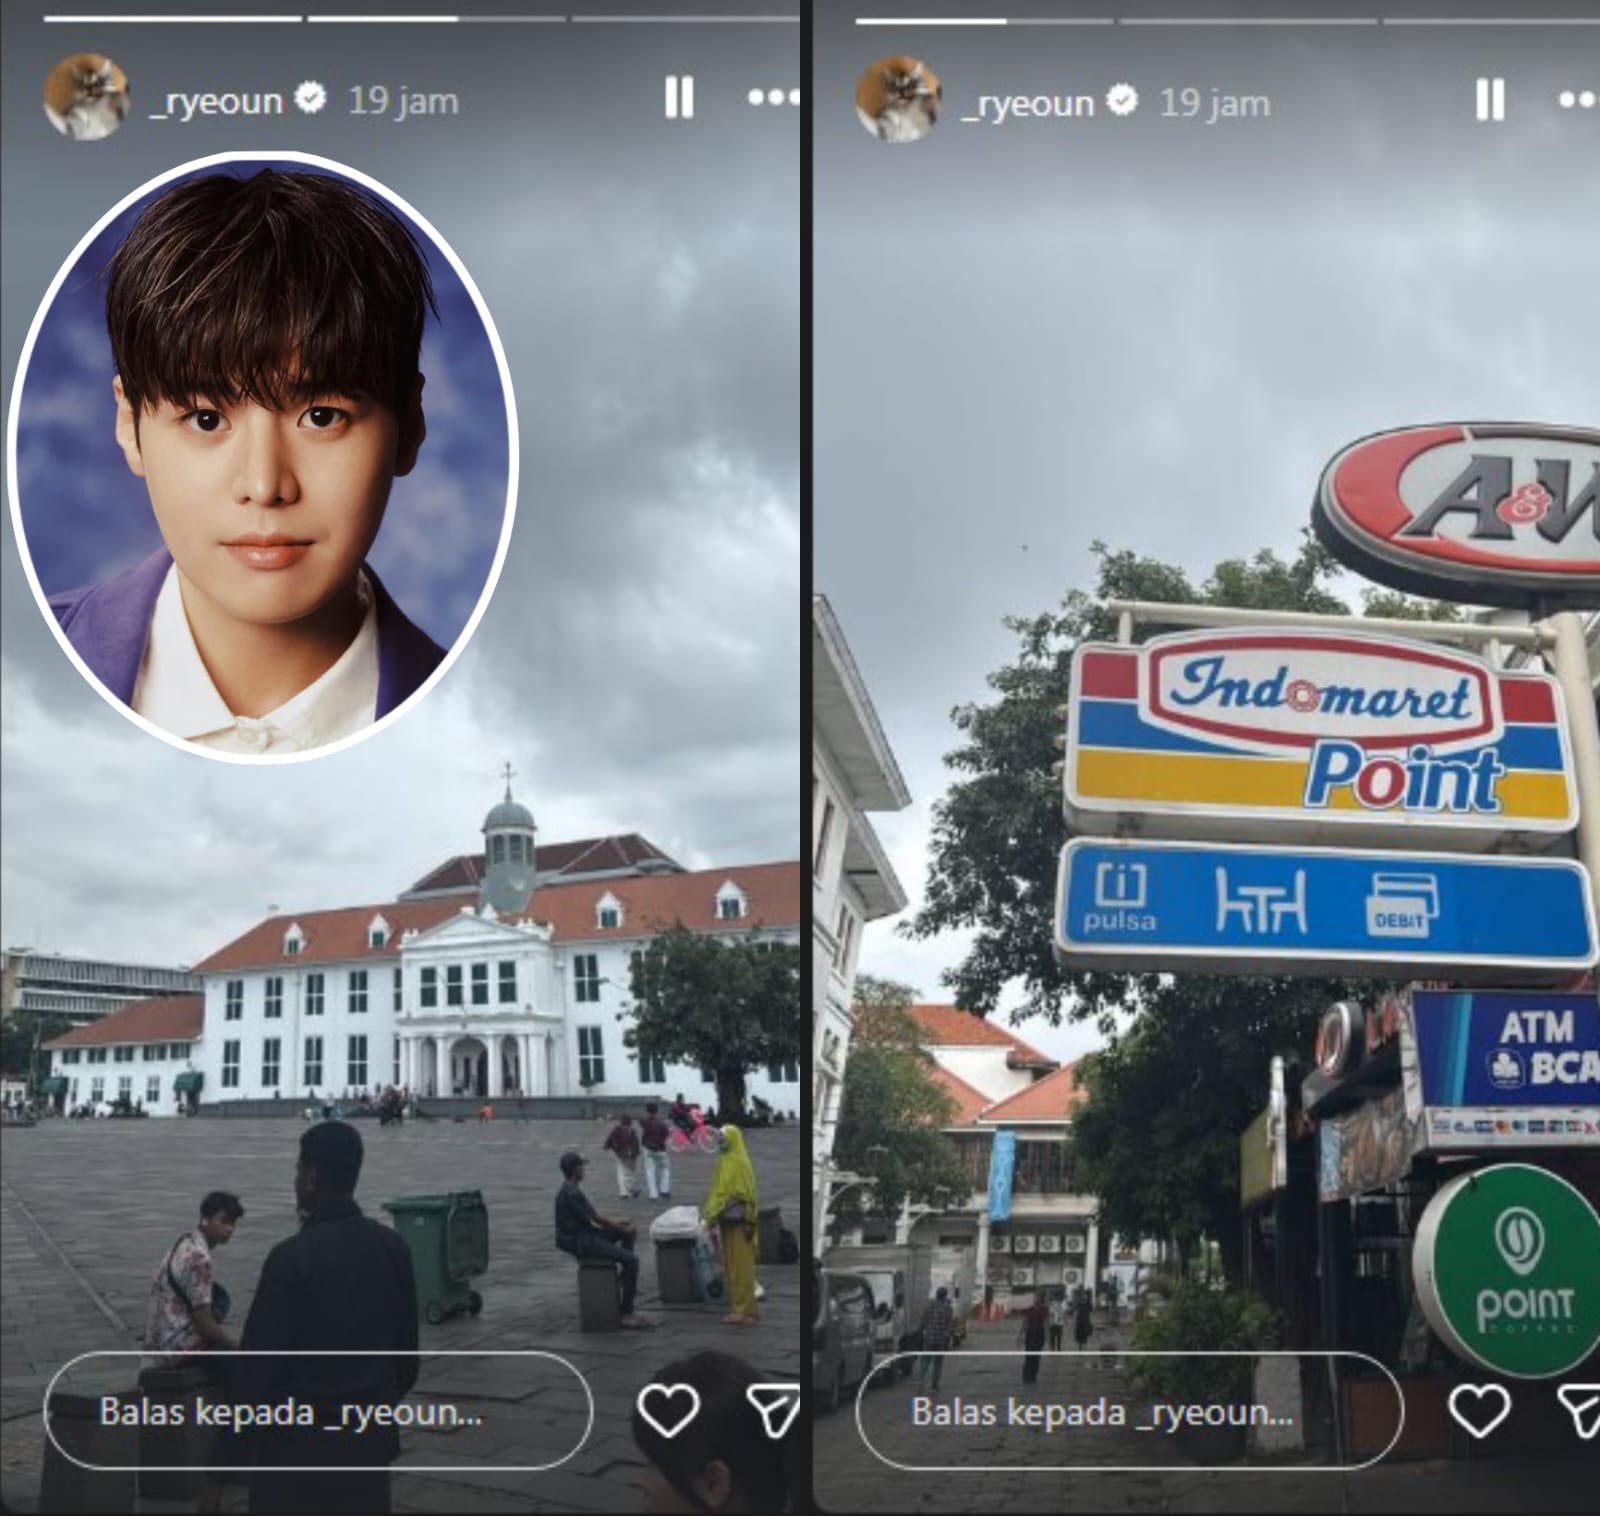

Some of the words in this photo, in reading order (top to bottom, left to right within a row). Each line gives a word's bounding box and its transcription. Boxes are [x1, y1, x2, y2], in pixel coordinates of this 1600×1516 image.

[1170, 656, 1472, 719] Indomaret
[1305, 739, 1504, 811] Point
[1083, 908, 1157, 936] pulsa
[1375, 912, 1424, 929] DEBIT
[1499, 1009, 1575, 1044] ATM
[1530, 1049, 1600, 1085] BCA
